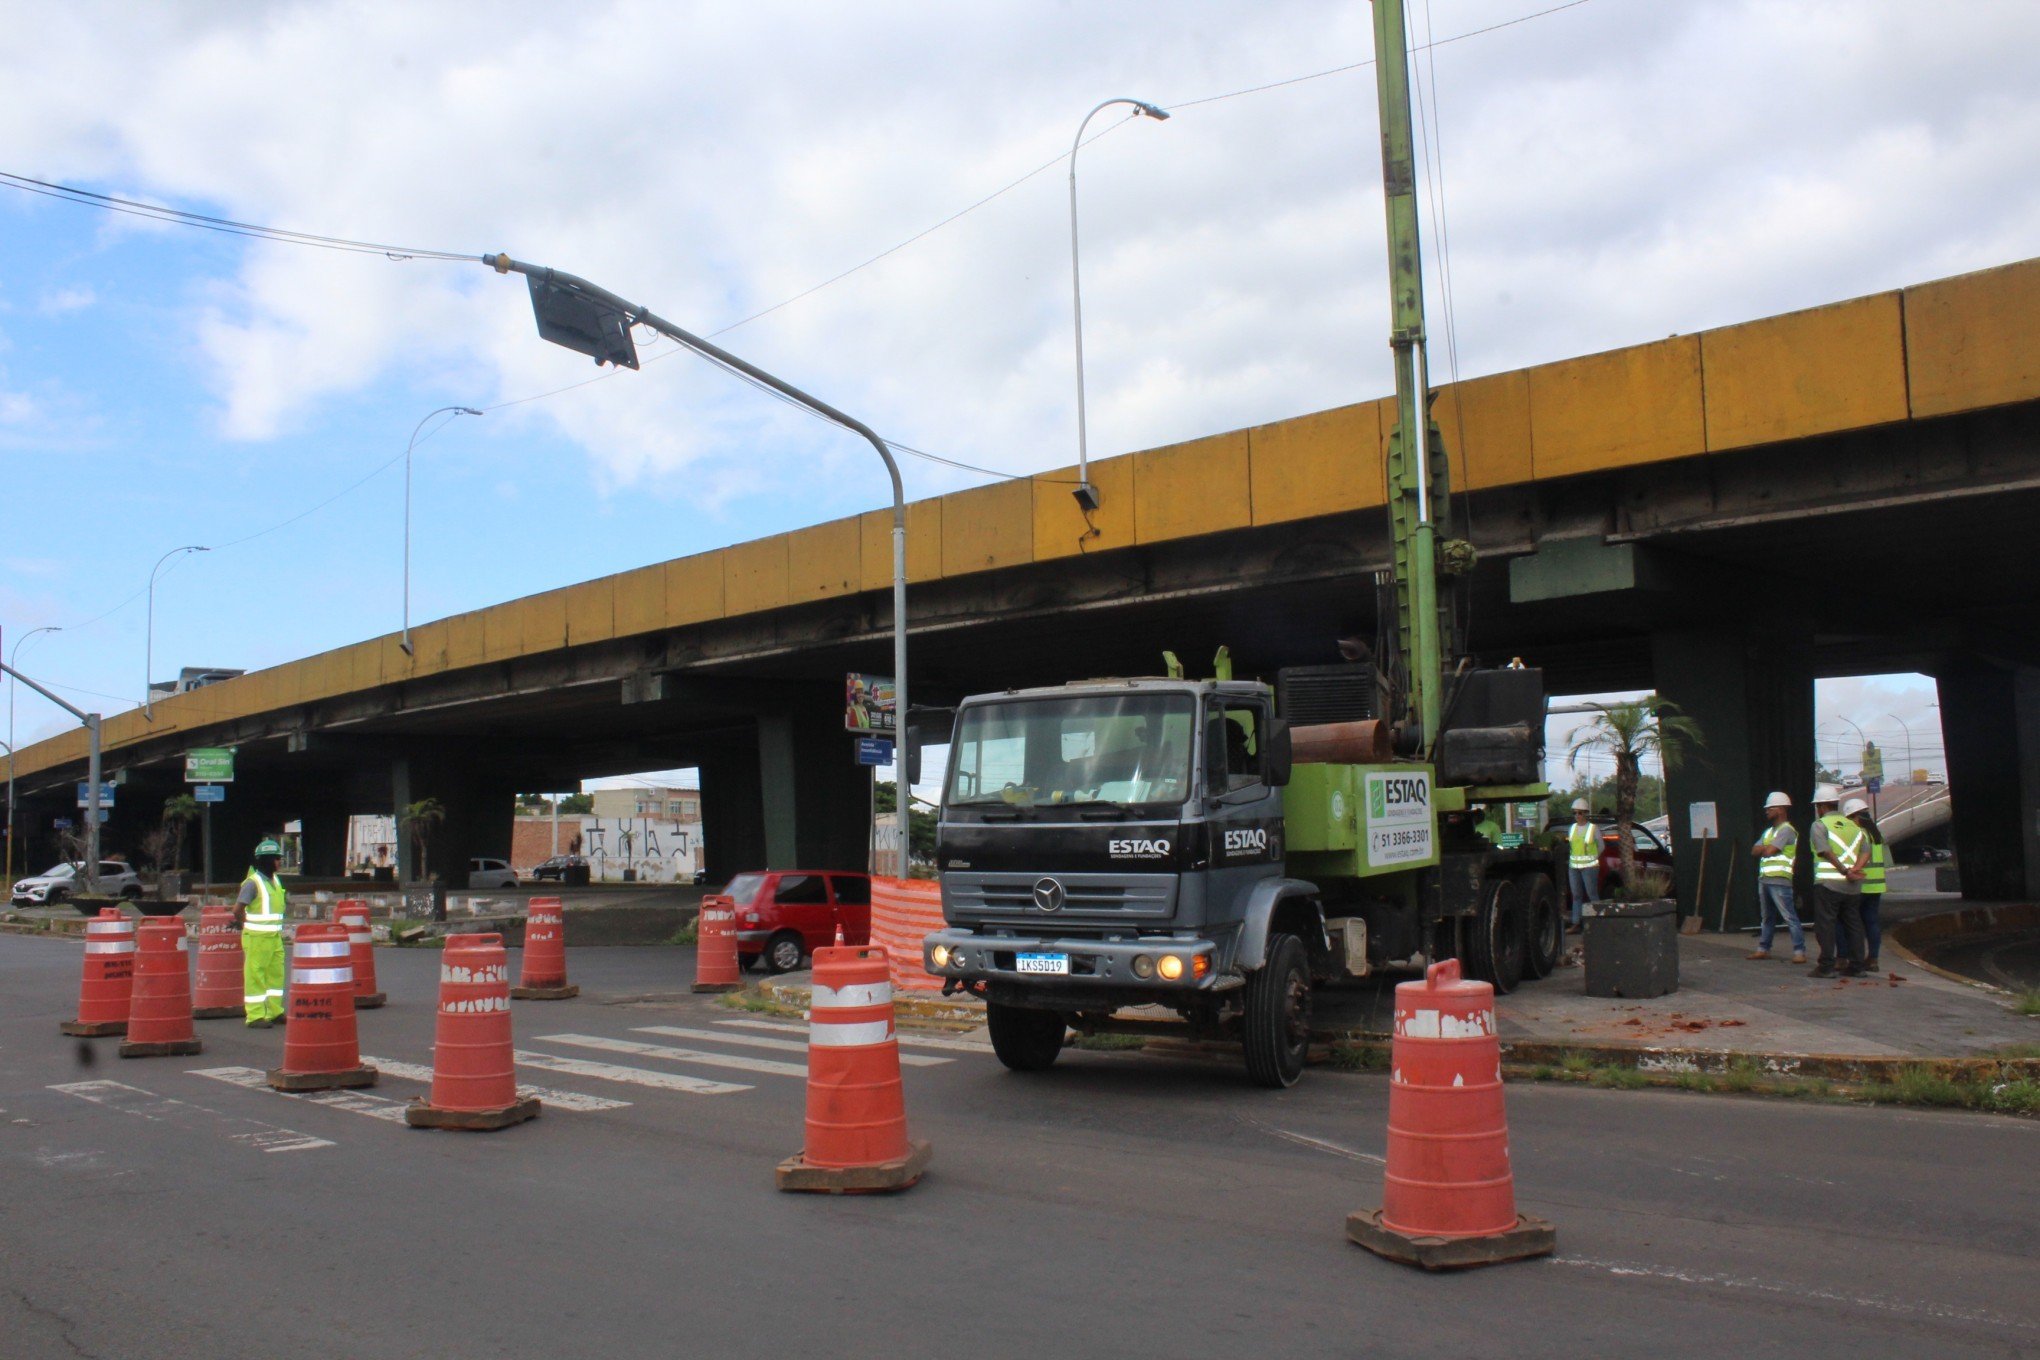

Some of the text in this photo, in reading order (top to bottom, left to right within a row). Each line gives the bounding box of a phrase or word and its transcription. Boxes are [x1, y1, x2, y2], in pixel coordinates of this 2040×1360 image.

[1385, 779, 1427, 806] ESTAQ
[1224, 829, 1267, 850] ESTAQ
[1382, 829, 1429, 847] 51 3366-3301
[1109, 839, 1171, 856] ESTAQ
[1021, 960, 1063, 972] IKS5D19
